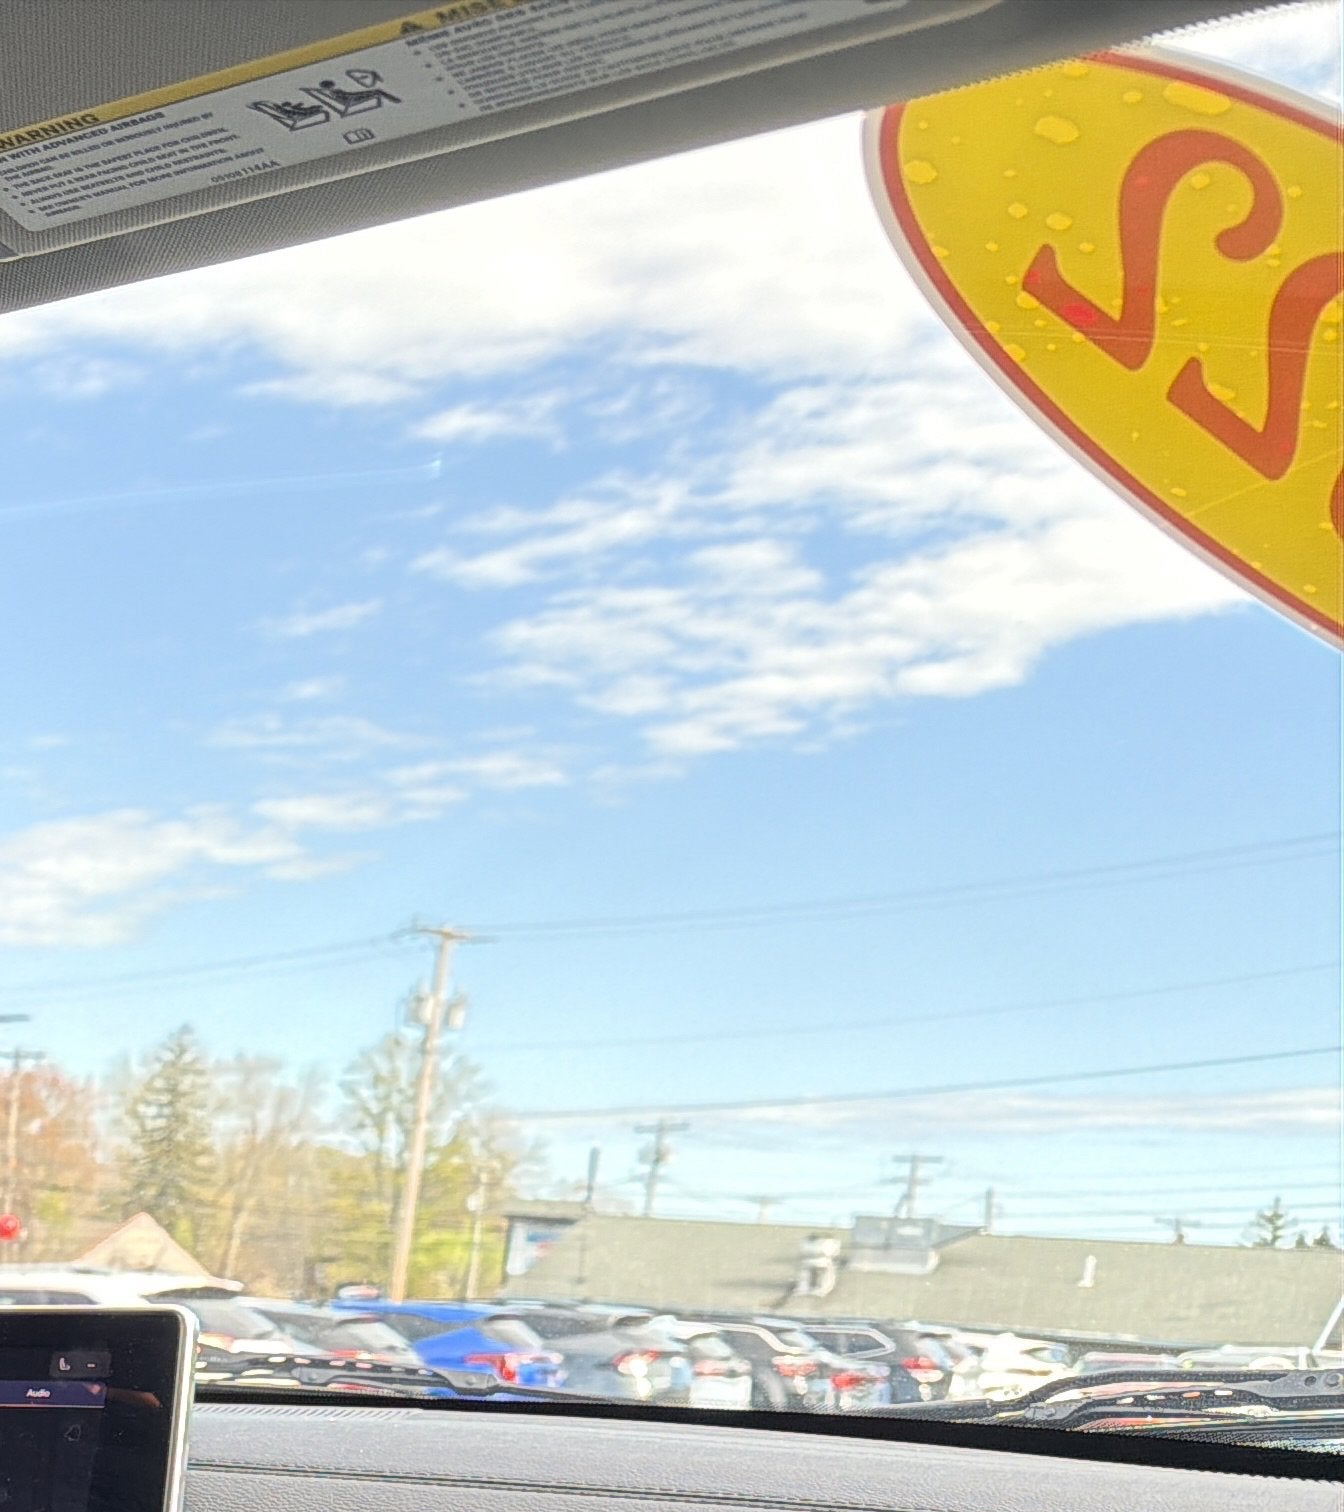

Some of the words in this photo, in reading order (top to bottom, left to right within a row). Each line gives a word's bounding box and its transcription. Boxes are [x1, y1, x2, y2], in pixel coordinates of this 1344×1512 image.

[8, 147, 42, 159] WITH
[40, 128, 110, 150] ADVANCED
[108, 112, 166, 131] AIRBAGS
[27, 1388, 50, 1398] Audio
